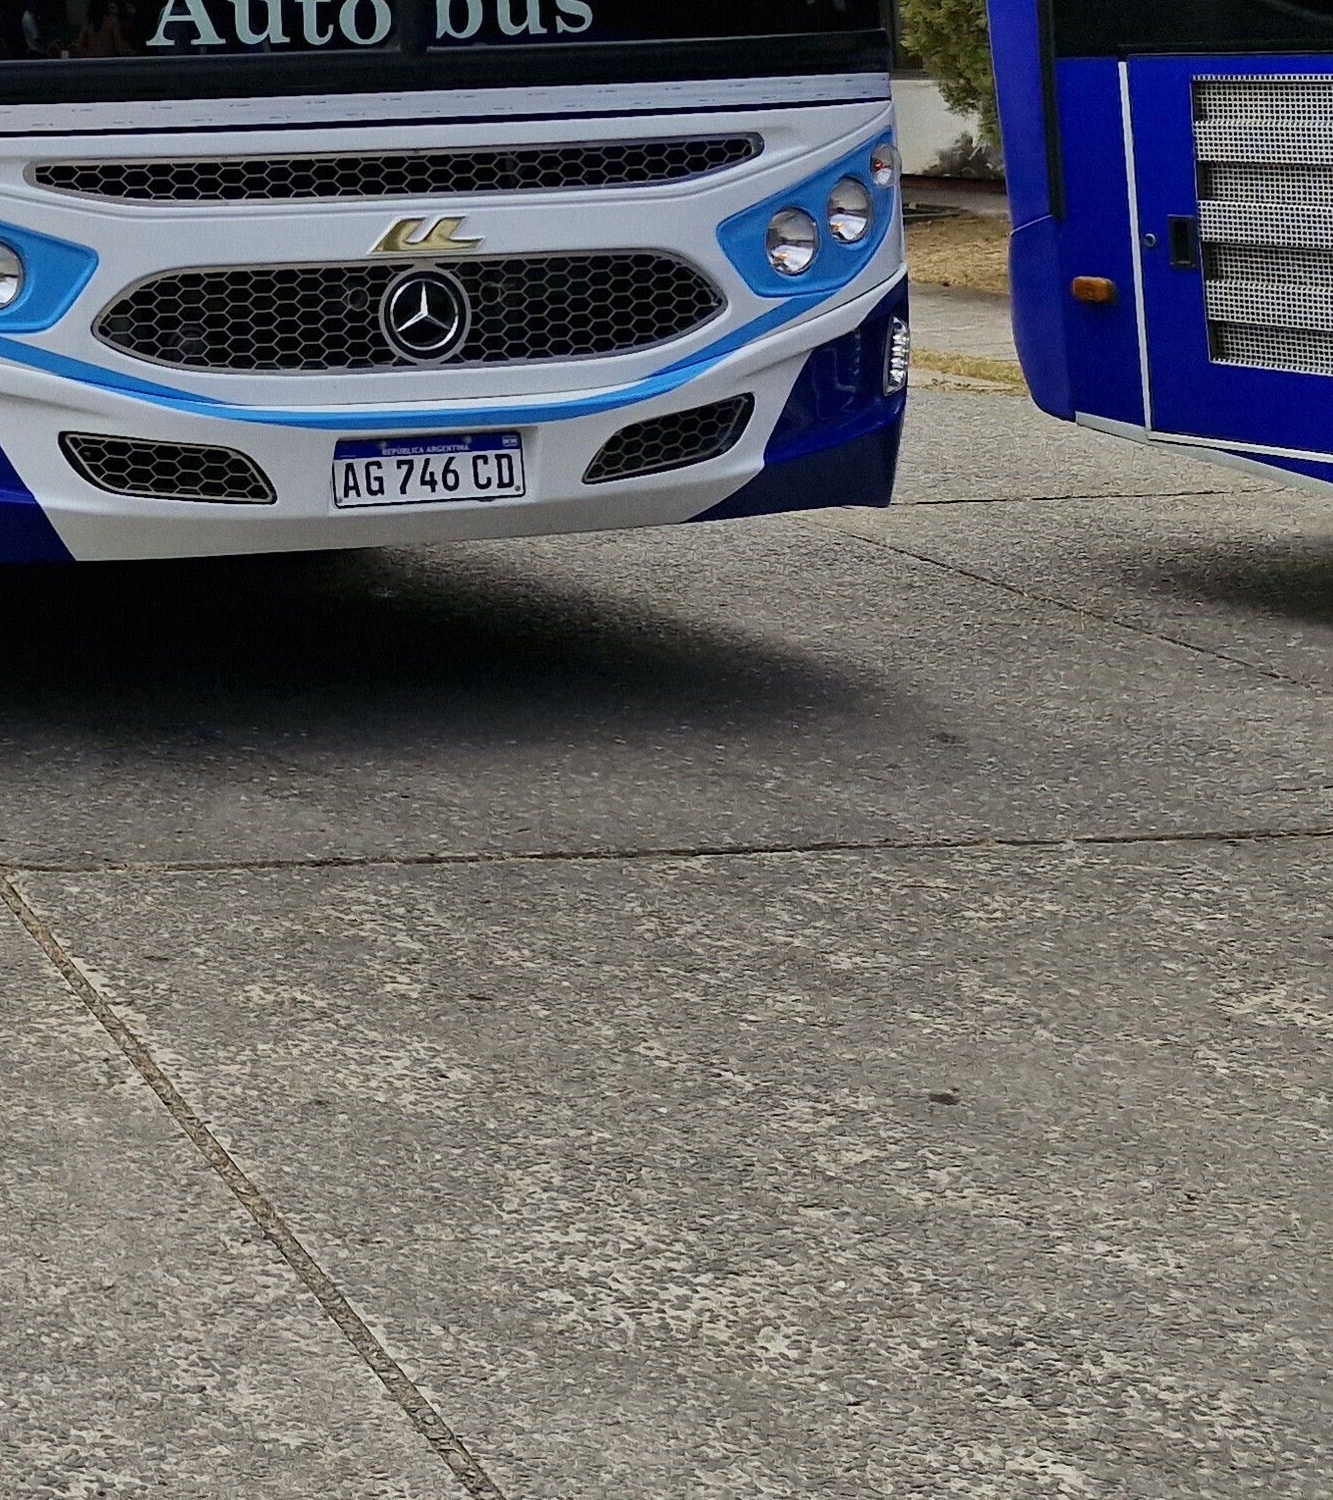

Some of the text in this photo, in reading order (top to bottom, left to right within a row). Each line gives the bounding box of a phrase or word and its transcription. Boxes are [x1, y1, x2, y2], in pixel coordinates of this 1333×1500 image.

[343, 453, 514, 498] AG 746 CD
